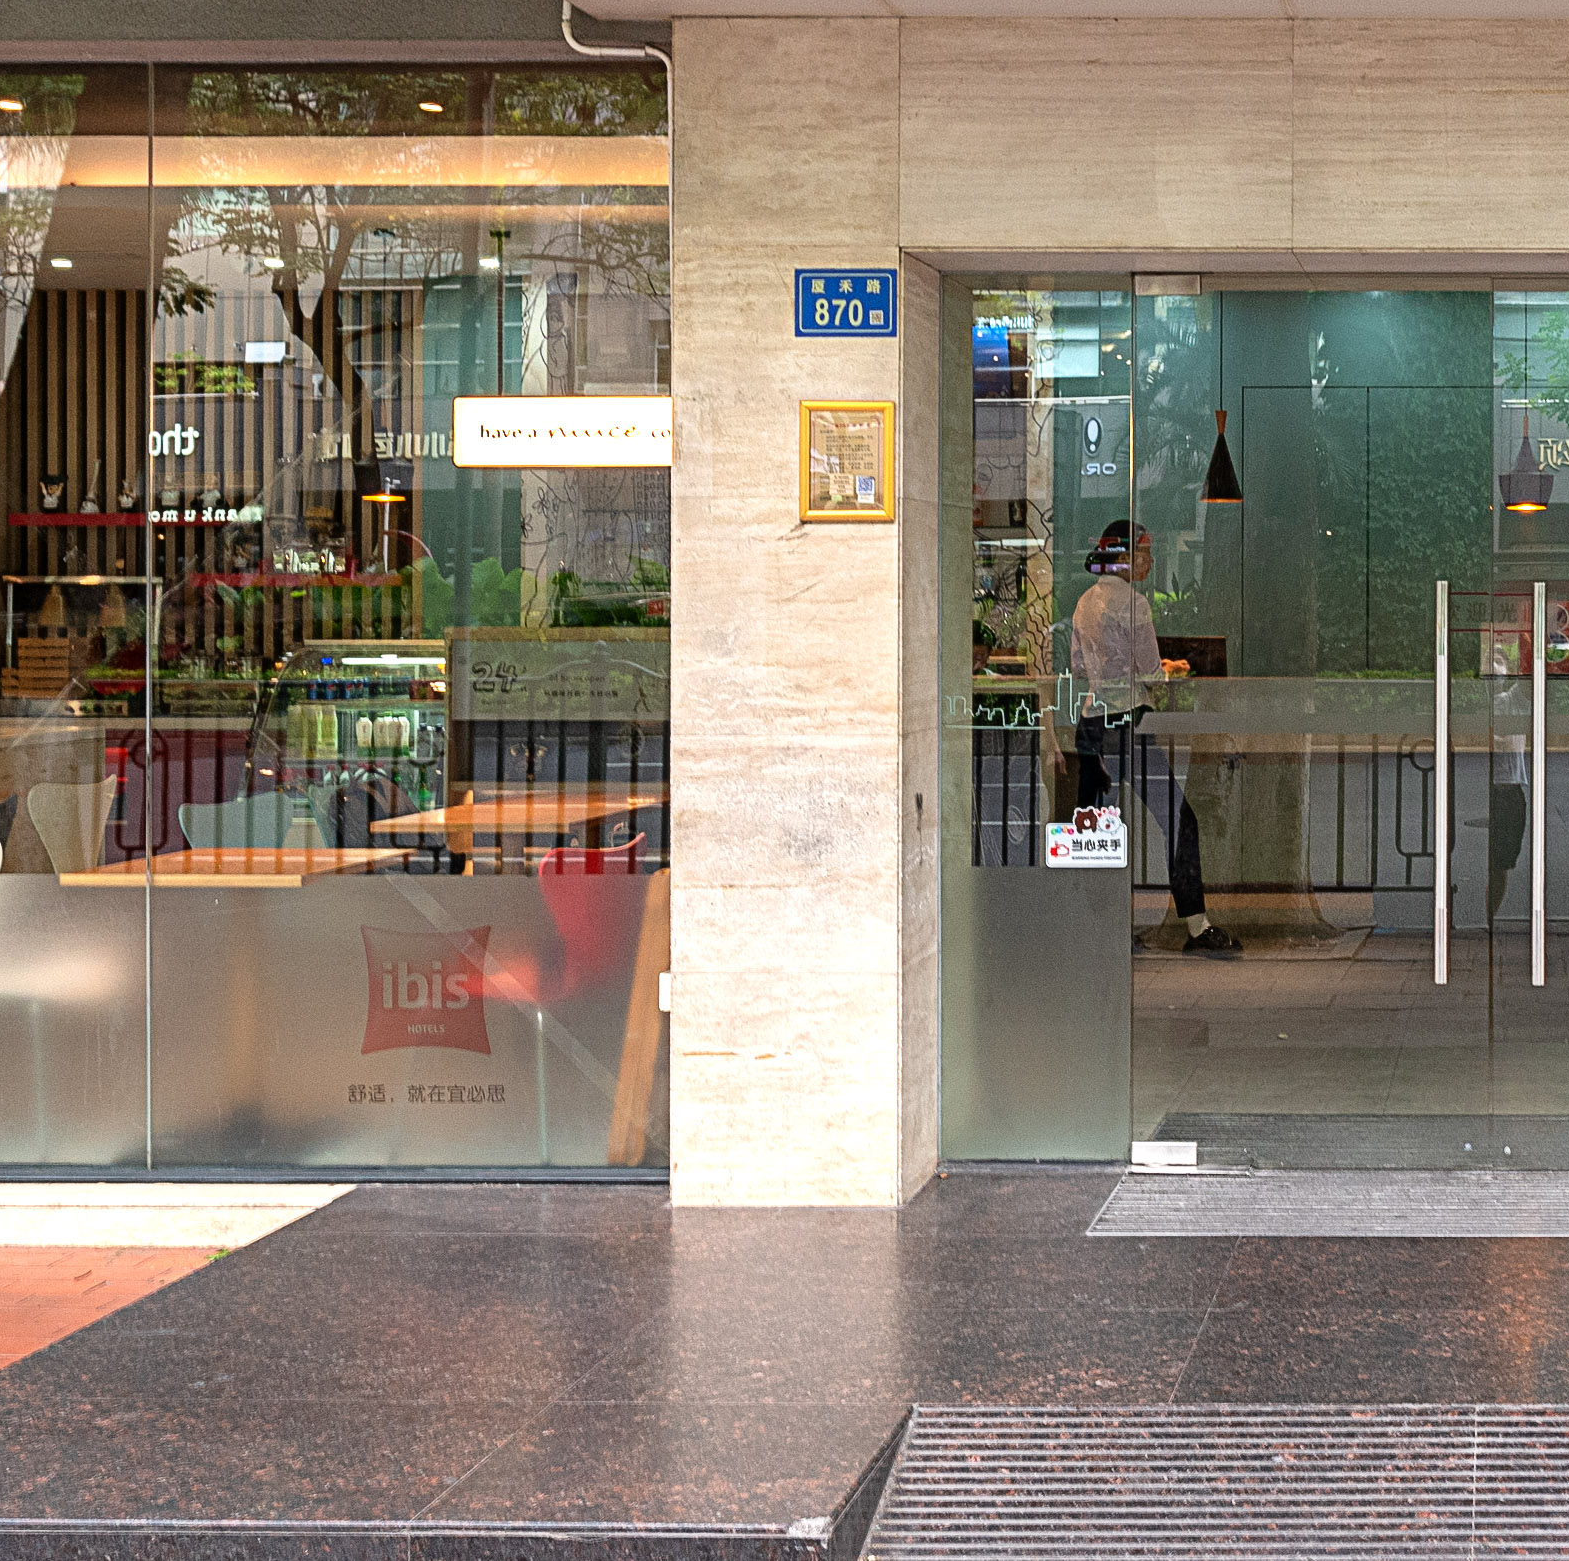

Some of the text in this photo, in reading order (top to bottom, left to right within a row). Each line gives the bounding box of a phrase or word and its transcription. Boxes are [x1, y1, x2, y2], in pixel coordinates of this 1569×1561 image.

[811, 278, 881, 295] 厦禾路
[814, 298, 864, 327] 870
[480, 424, 522, 438] have
[528, 428, 537, 438] a
[1071, 838, 1122, 852] 当心夹手
[381, 960, 470, 1011] ibis
[407, 1024, 446, 1034] HOTELS
